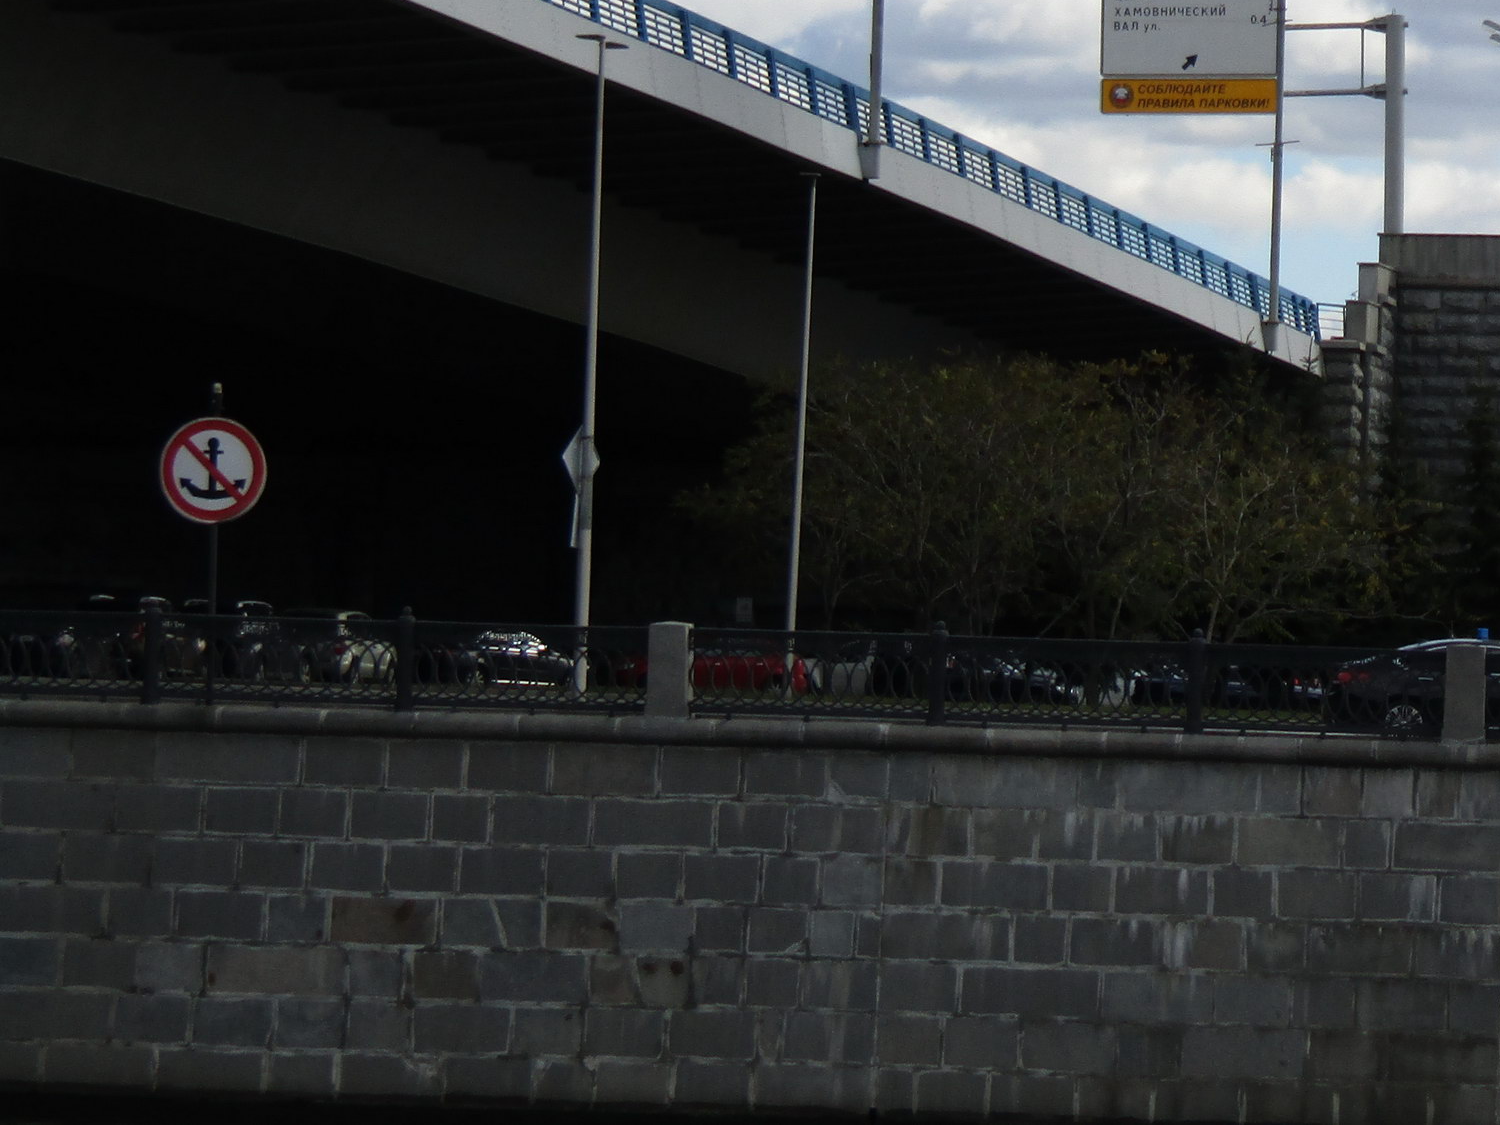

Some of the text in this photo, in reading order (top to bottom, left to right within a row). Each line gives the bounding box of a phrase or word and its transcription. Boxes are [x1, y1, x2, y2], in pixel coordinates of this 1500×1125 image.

[1115, 5, 1226, 16] ХАМОВНИЧЕСКИЙ
[1113, 21, 1139, 31] ВАЛ
[1138, 84, 1226, 95] СОБЛЮДАЙТЕ
[1137, 99, 1269, 108] ПРАВИЛА ПАРКОВКИ!
